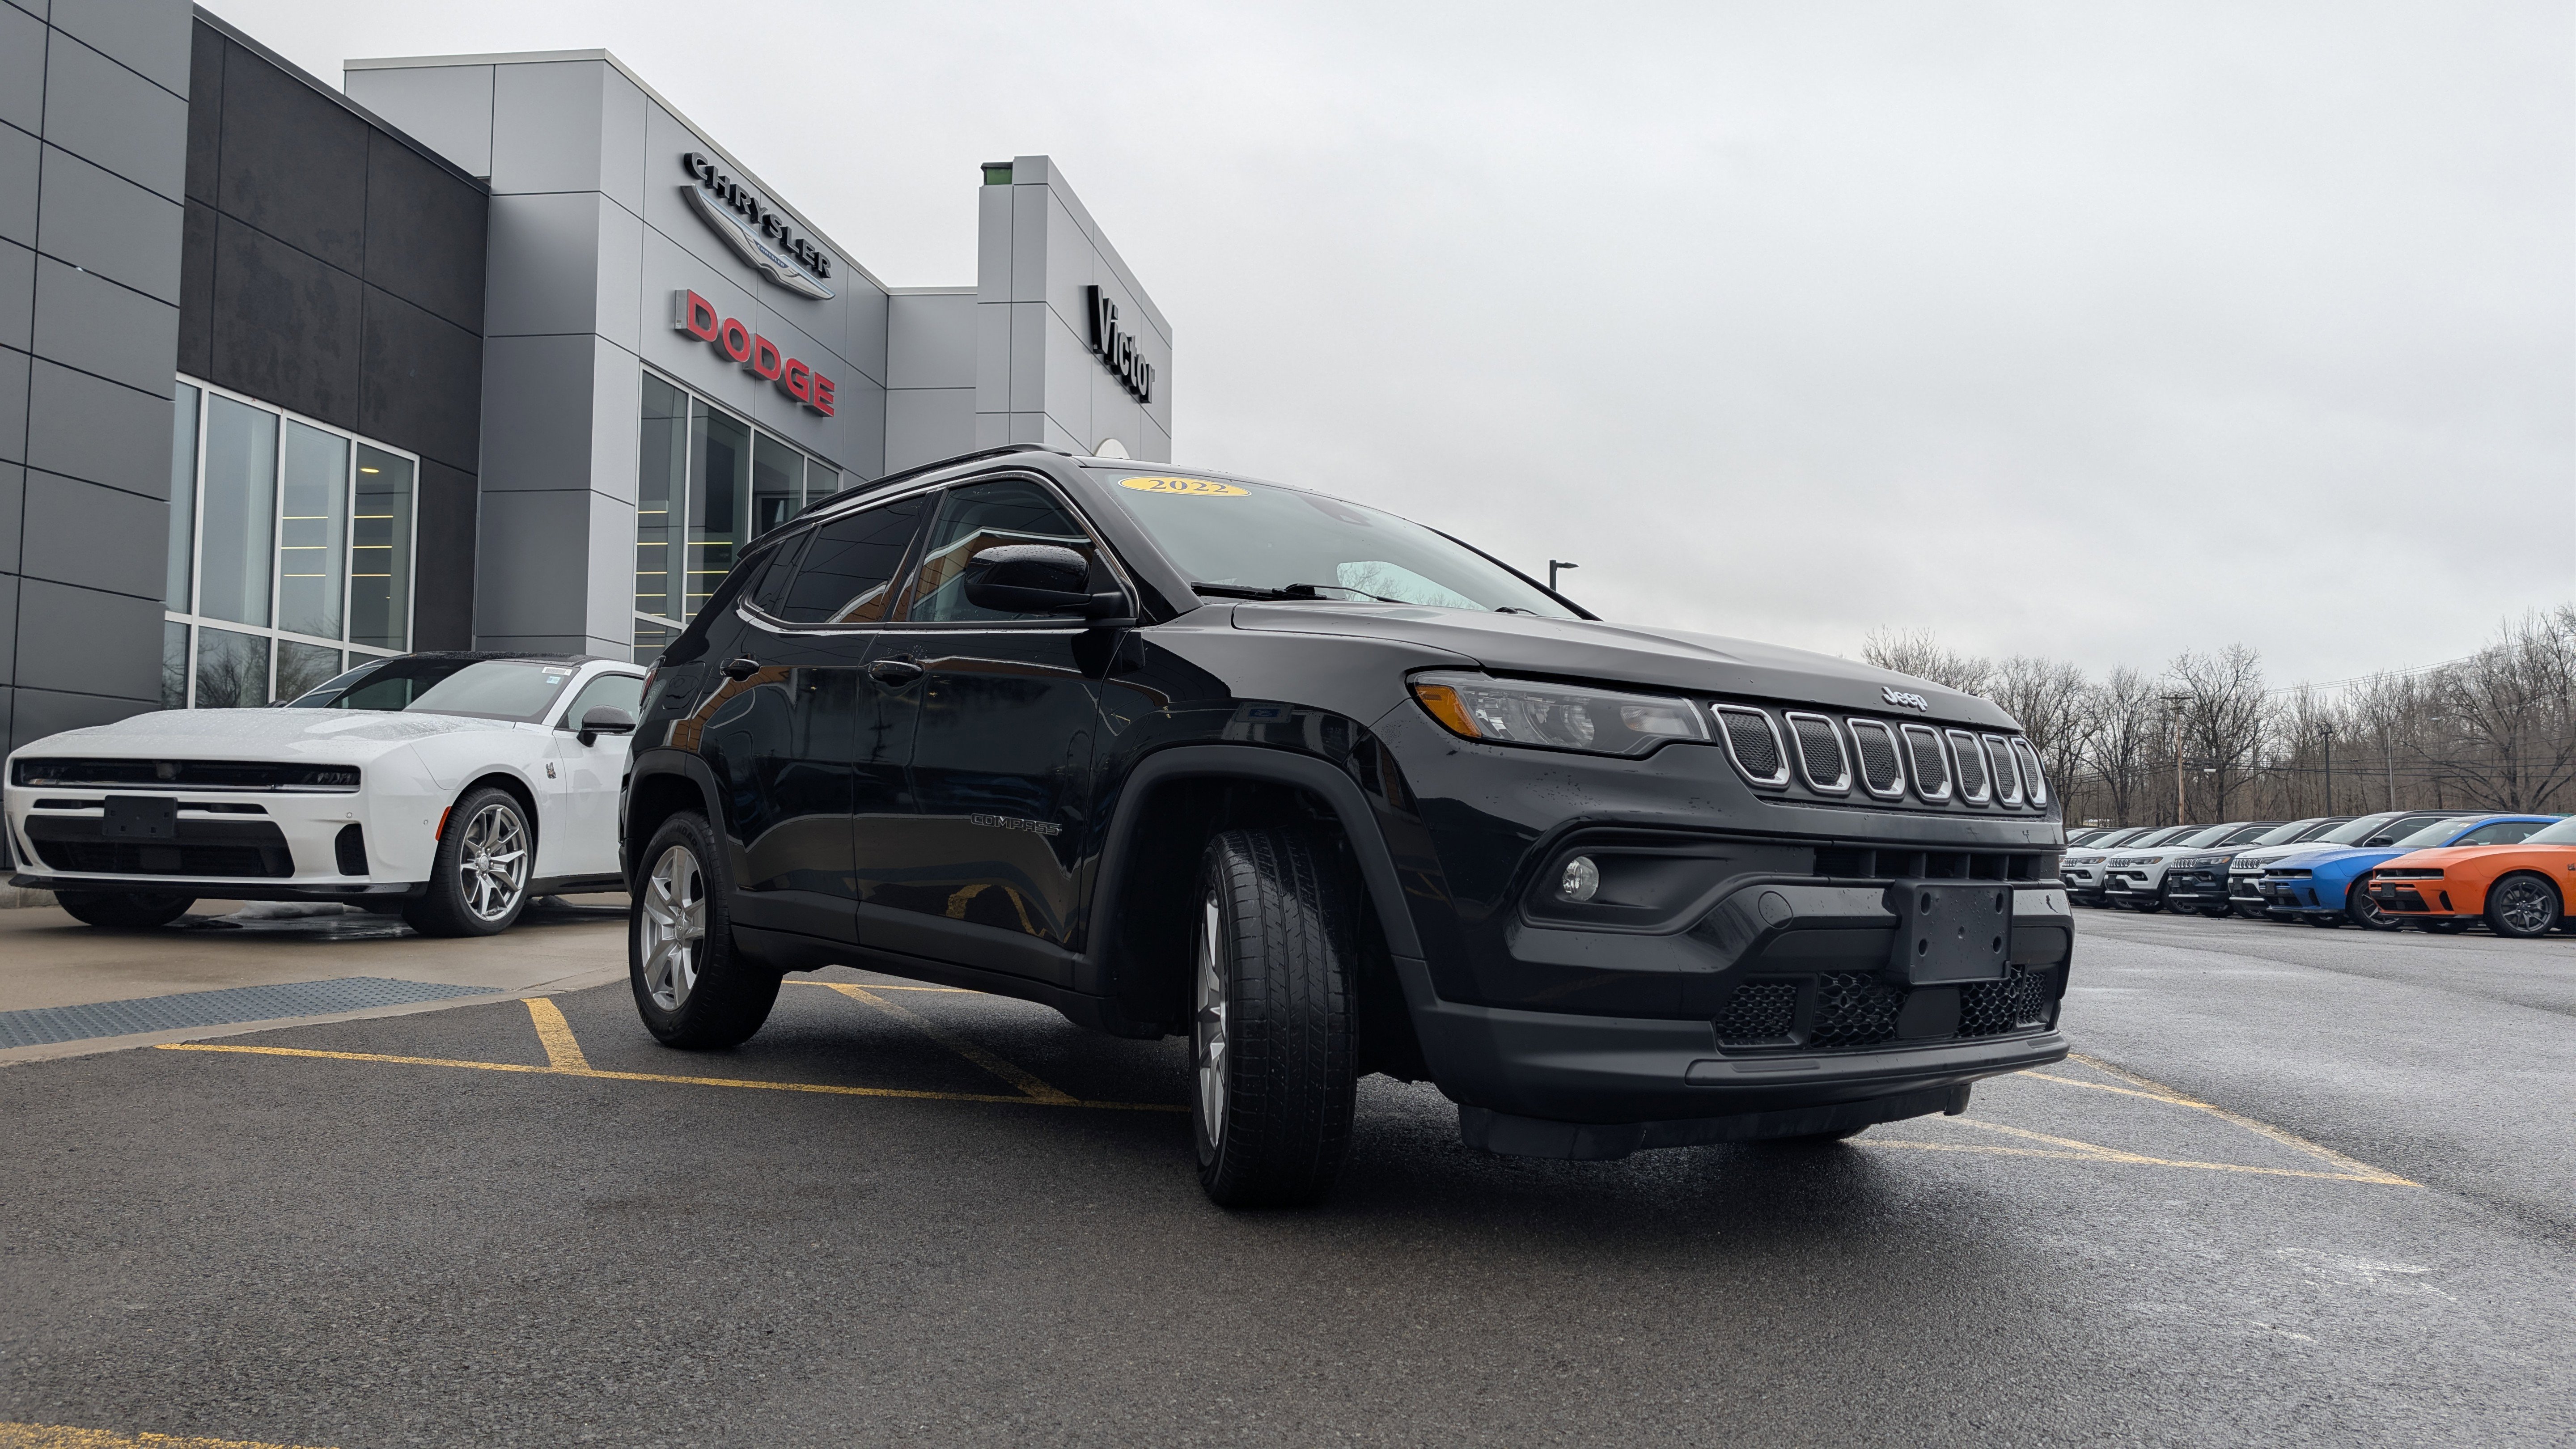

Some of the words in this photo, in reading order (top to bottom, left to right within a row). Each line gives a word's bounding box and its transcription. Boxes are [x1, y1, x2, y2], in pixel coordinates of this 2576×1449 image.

[684, 152, 832, 279] CHRYSLER
[757, 244, 784, 267] CHRYSLER
[676, 289, 835, 417] DODGE
[1088, 285, 1155, 403] Victor
[1148, 479, 1229, 494] 2022
[1881, 686, 1928, 712] Jeep
[970, 813, 1062, 836] COMPASS
